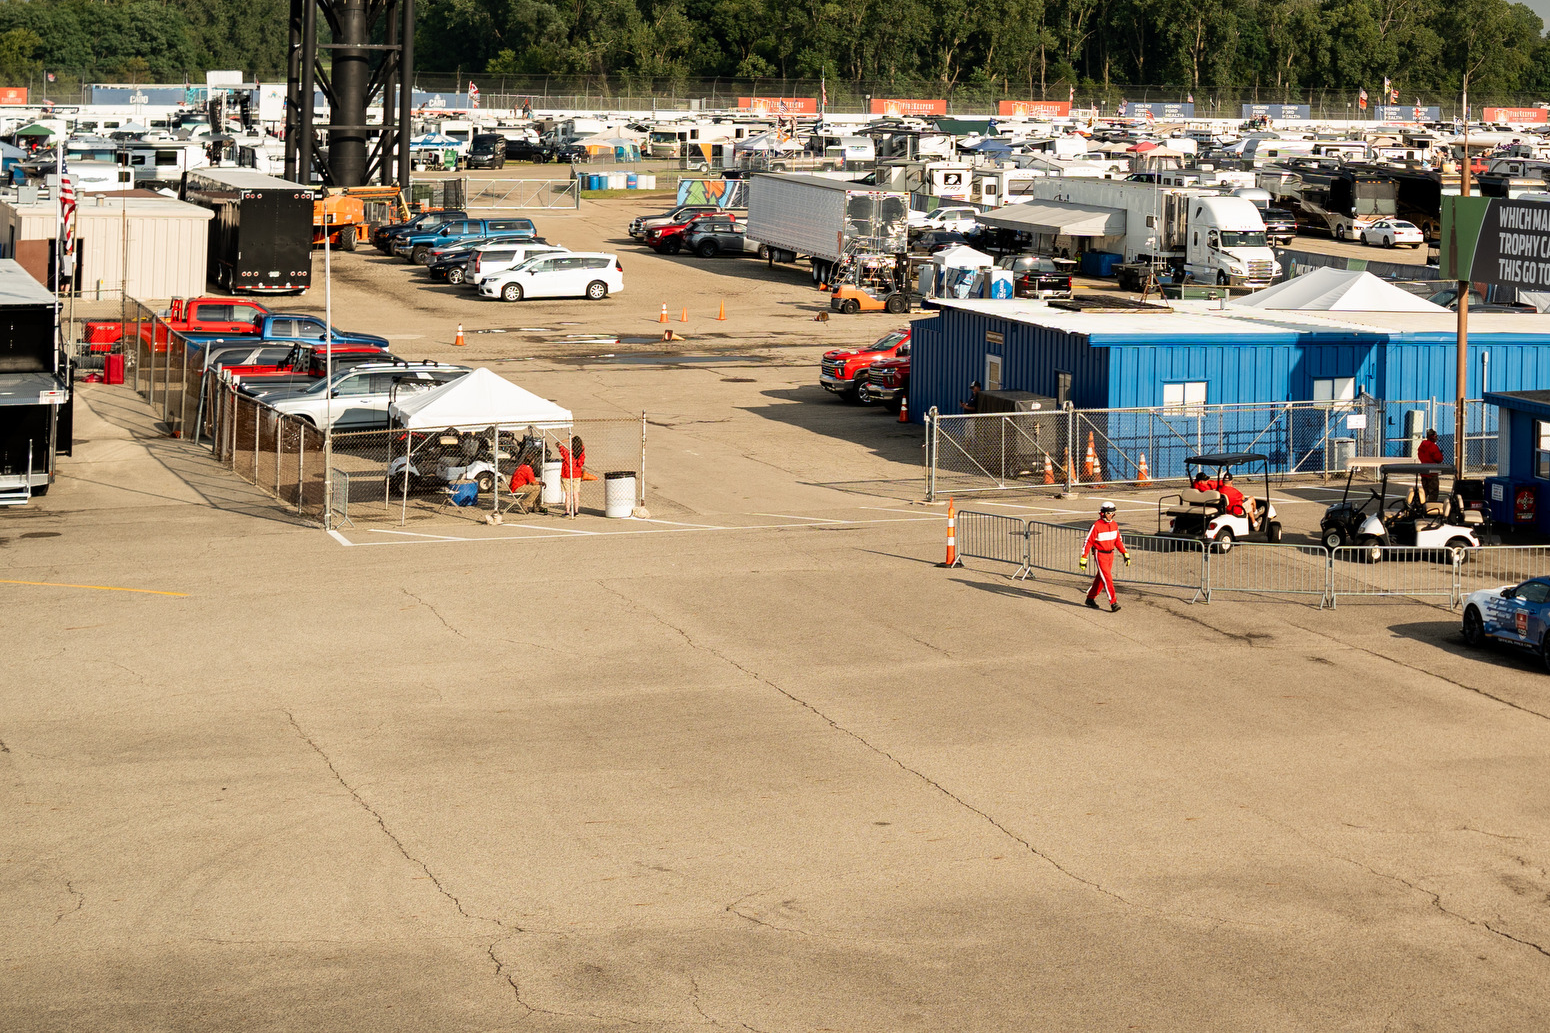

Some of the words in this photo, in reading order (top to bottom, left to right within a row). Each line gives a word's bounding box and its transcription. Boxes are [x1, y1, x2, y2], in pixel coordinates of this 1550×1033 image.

[1499, 206, 1532, 230] WHICH
[1499, 233, 1540, 257] TROPHY
[1498, 258, 1521, 282] THIS
[1522, 261, 1537, 284] GO
